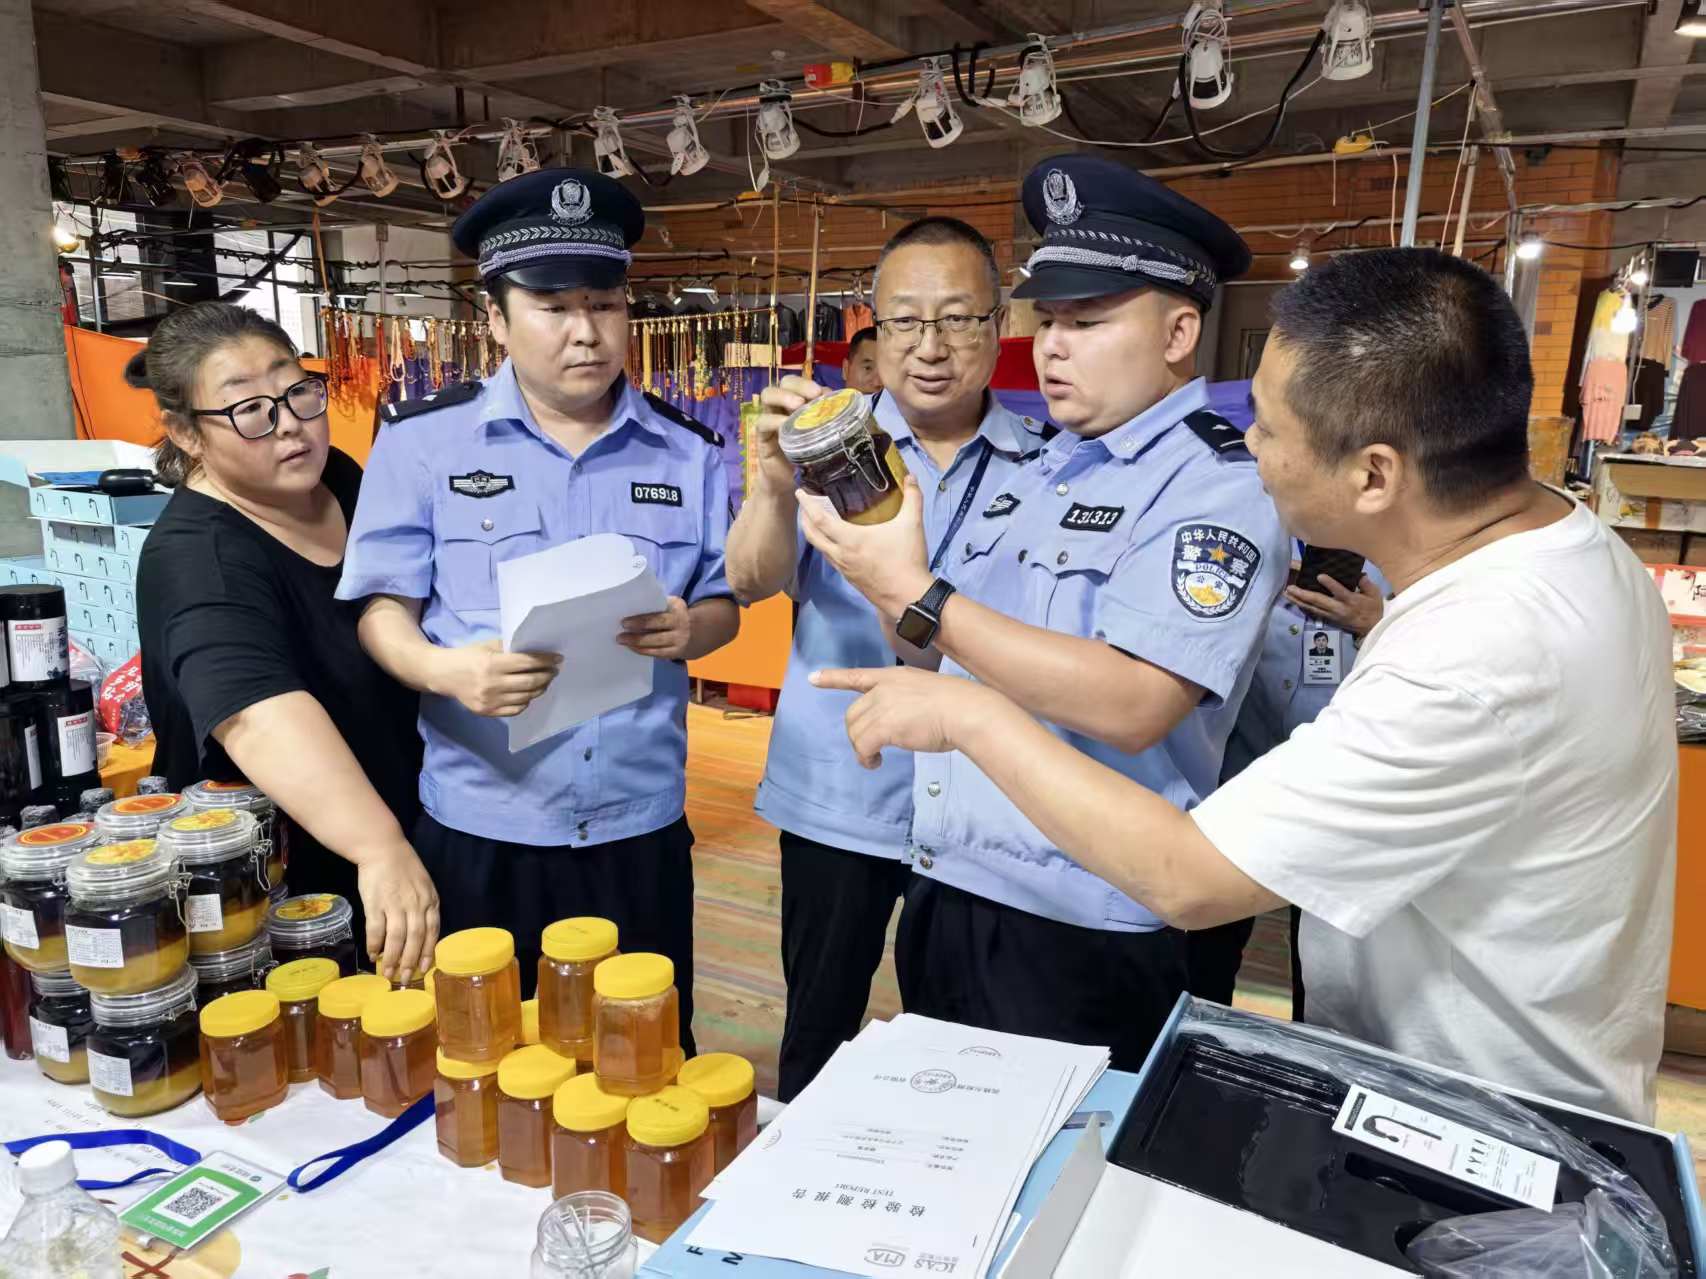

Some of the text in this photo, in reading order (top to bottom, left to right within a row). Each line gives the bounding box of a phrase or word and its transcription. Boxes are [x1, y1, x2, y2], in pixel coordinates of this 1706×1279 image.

[634, 487, 679, 502] 076918
[1181, 528, 1257, 562] 中华人民共和国
[791, 1188, 926, 1217] 检验检测报告
[914, 1258, 957, 1274] ICAS
